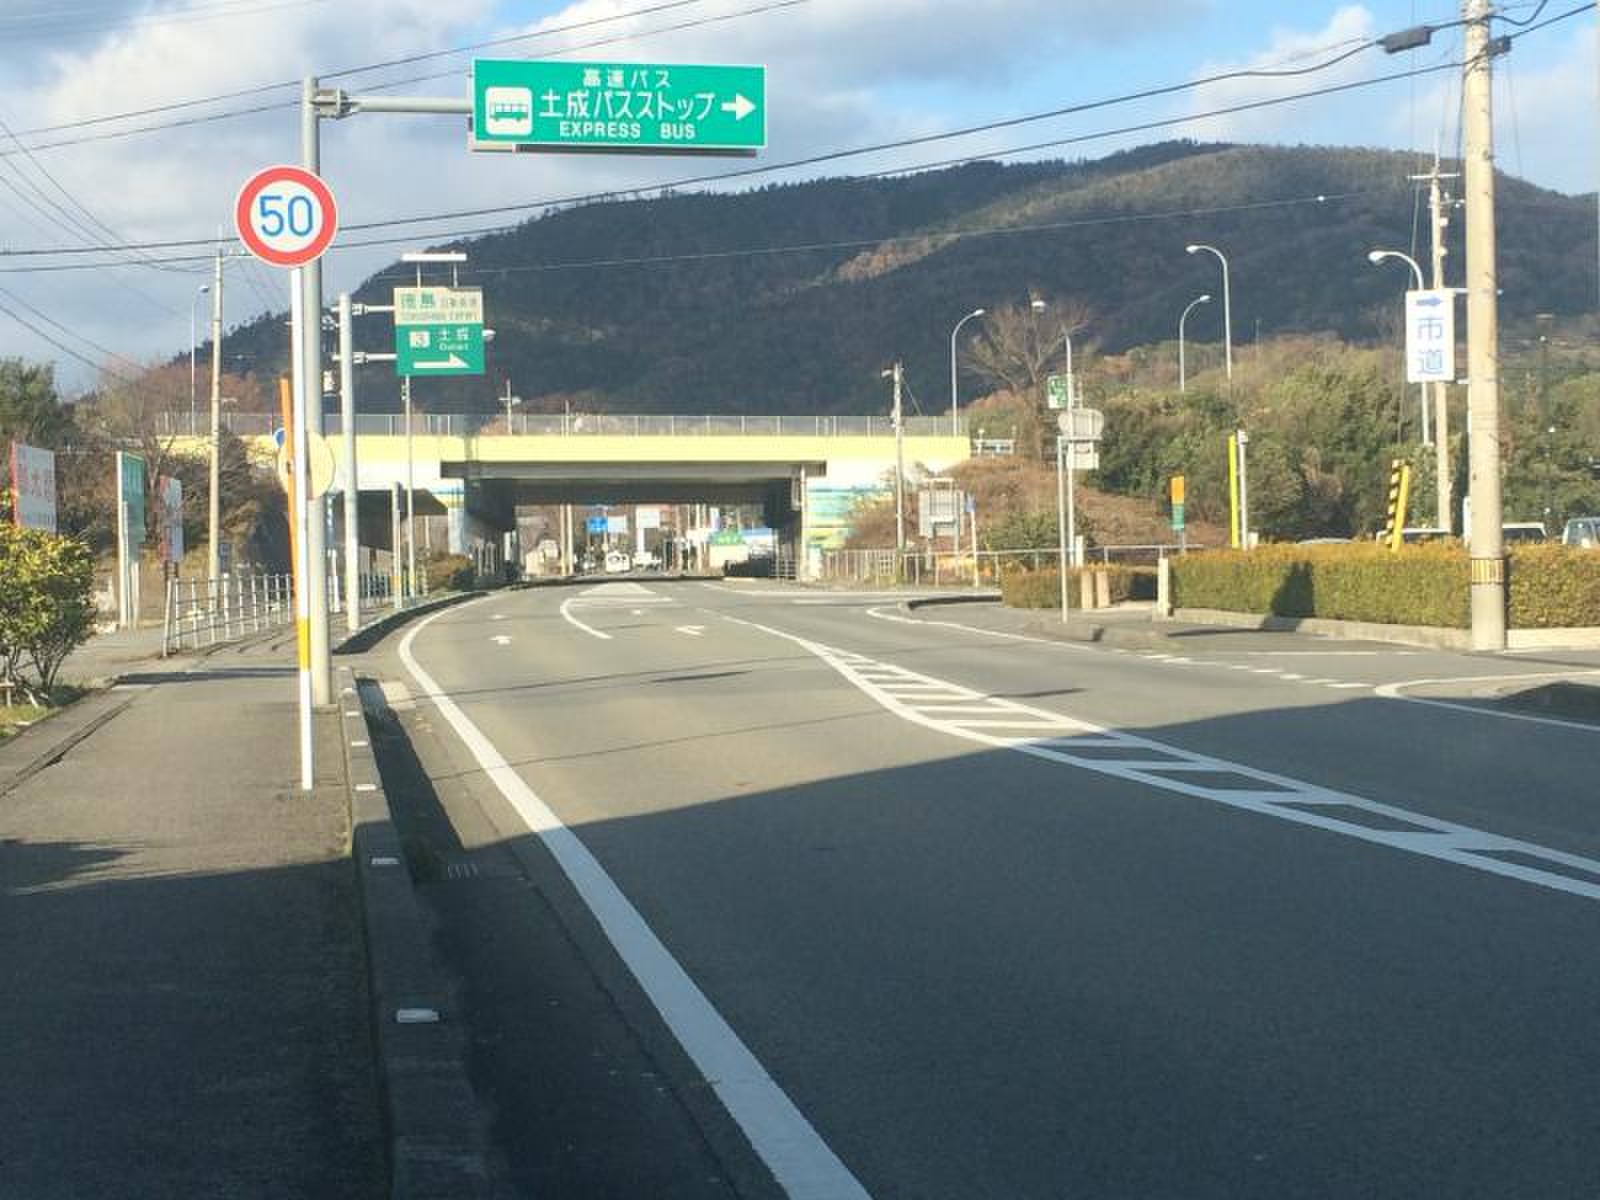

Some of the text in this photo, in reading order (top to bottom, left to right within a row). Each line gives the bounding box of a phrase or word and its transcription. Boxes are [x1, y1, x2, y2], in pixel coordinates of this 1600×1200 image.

[583, 69, 671, 88] 高速バス
[540, 90, 715, 120] 土成バスストップ
[560, 122, 696, 139] EXPRESS BUS
[259, 195, 313, 237] 50
[1415, 315, 1445, 375] 市道
